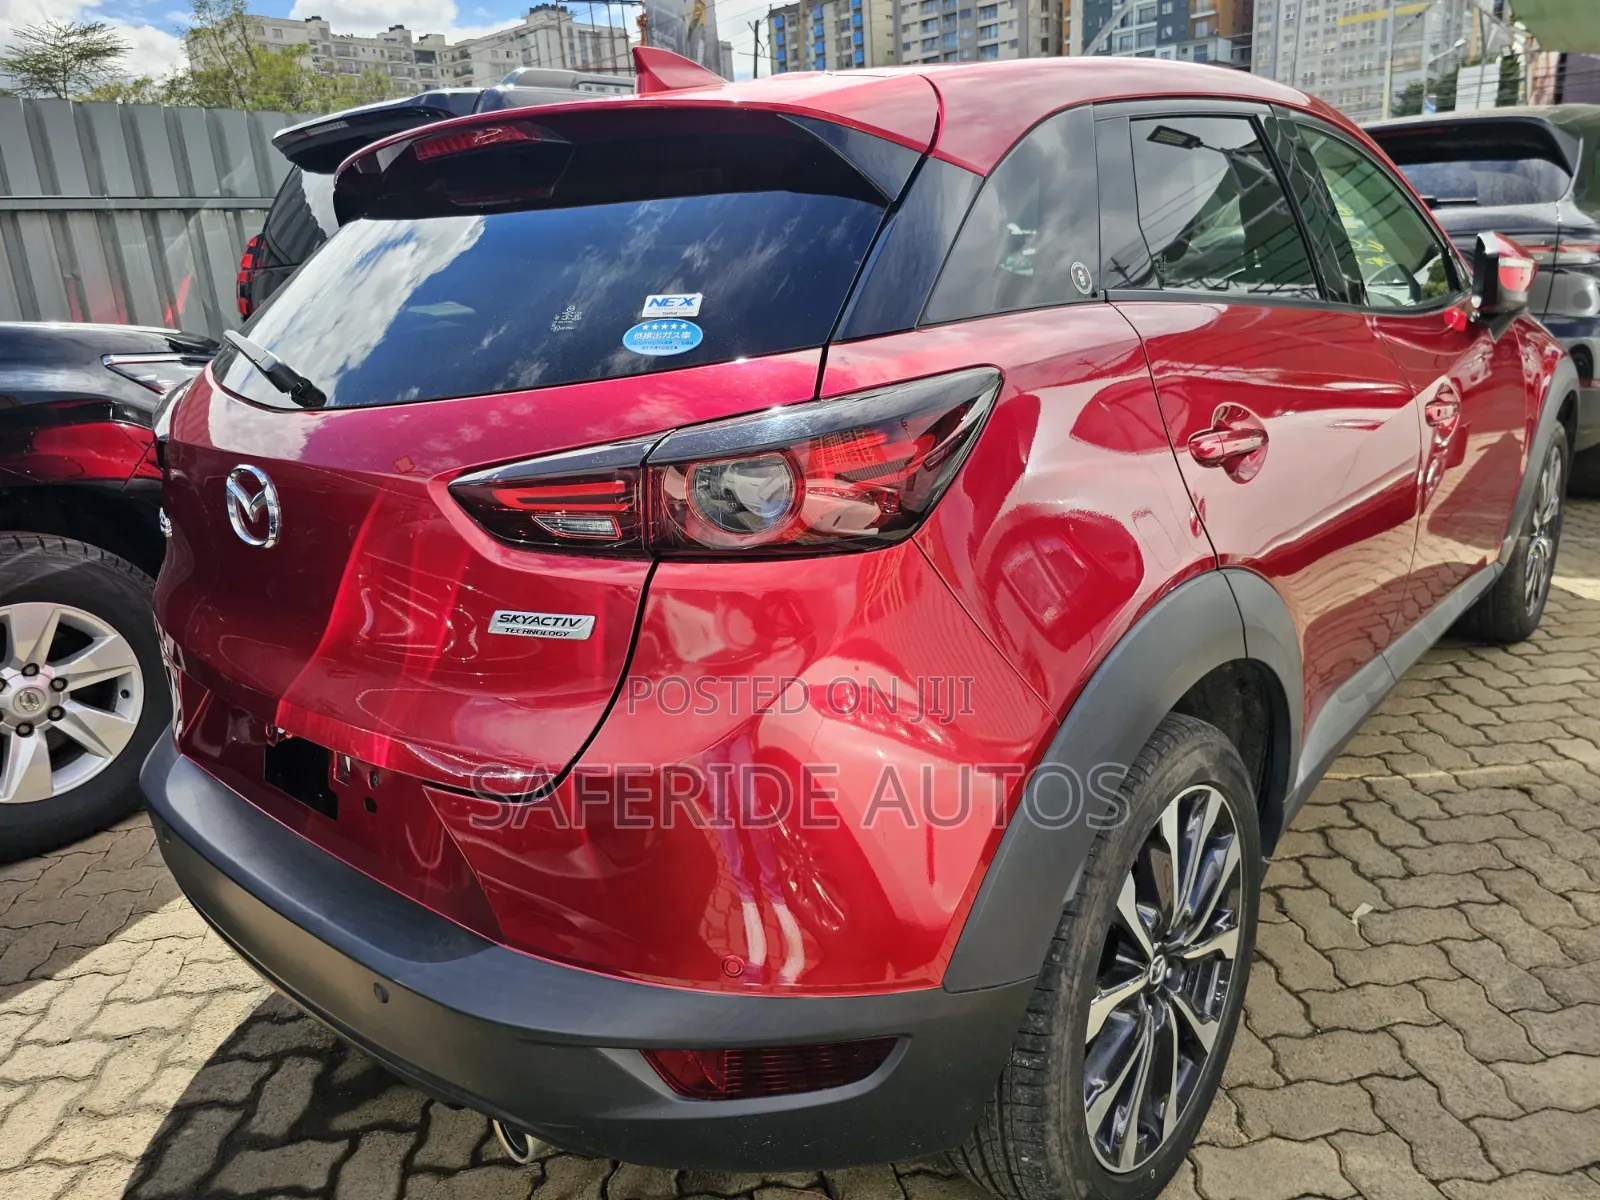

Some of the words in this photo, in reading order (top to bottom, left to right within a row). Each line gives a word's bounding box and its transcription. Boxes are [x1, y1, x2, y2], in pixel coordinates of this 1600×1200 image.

[648, 297, 697, 307] NEX
[634, 331, 692, 340] 低排出ガス車
[498, 613, 582, 628] SKYACTIV
[505, 627, 570, 637] TECHNOLOGY
